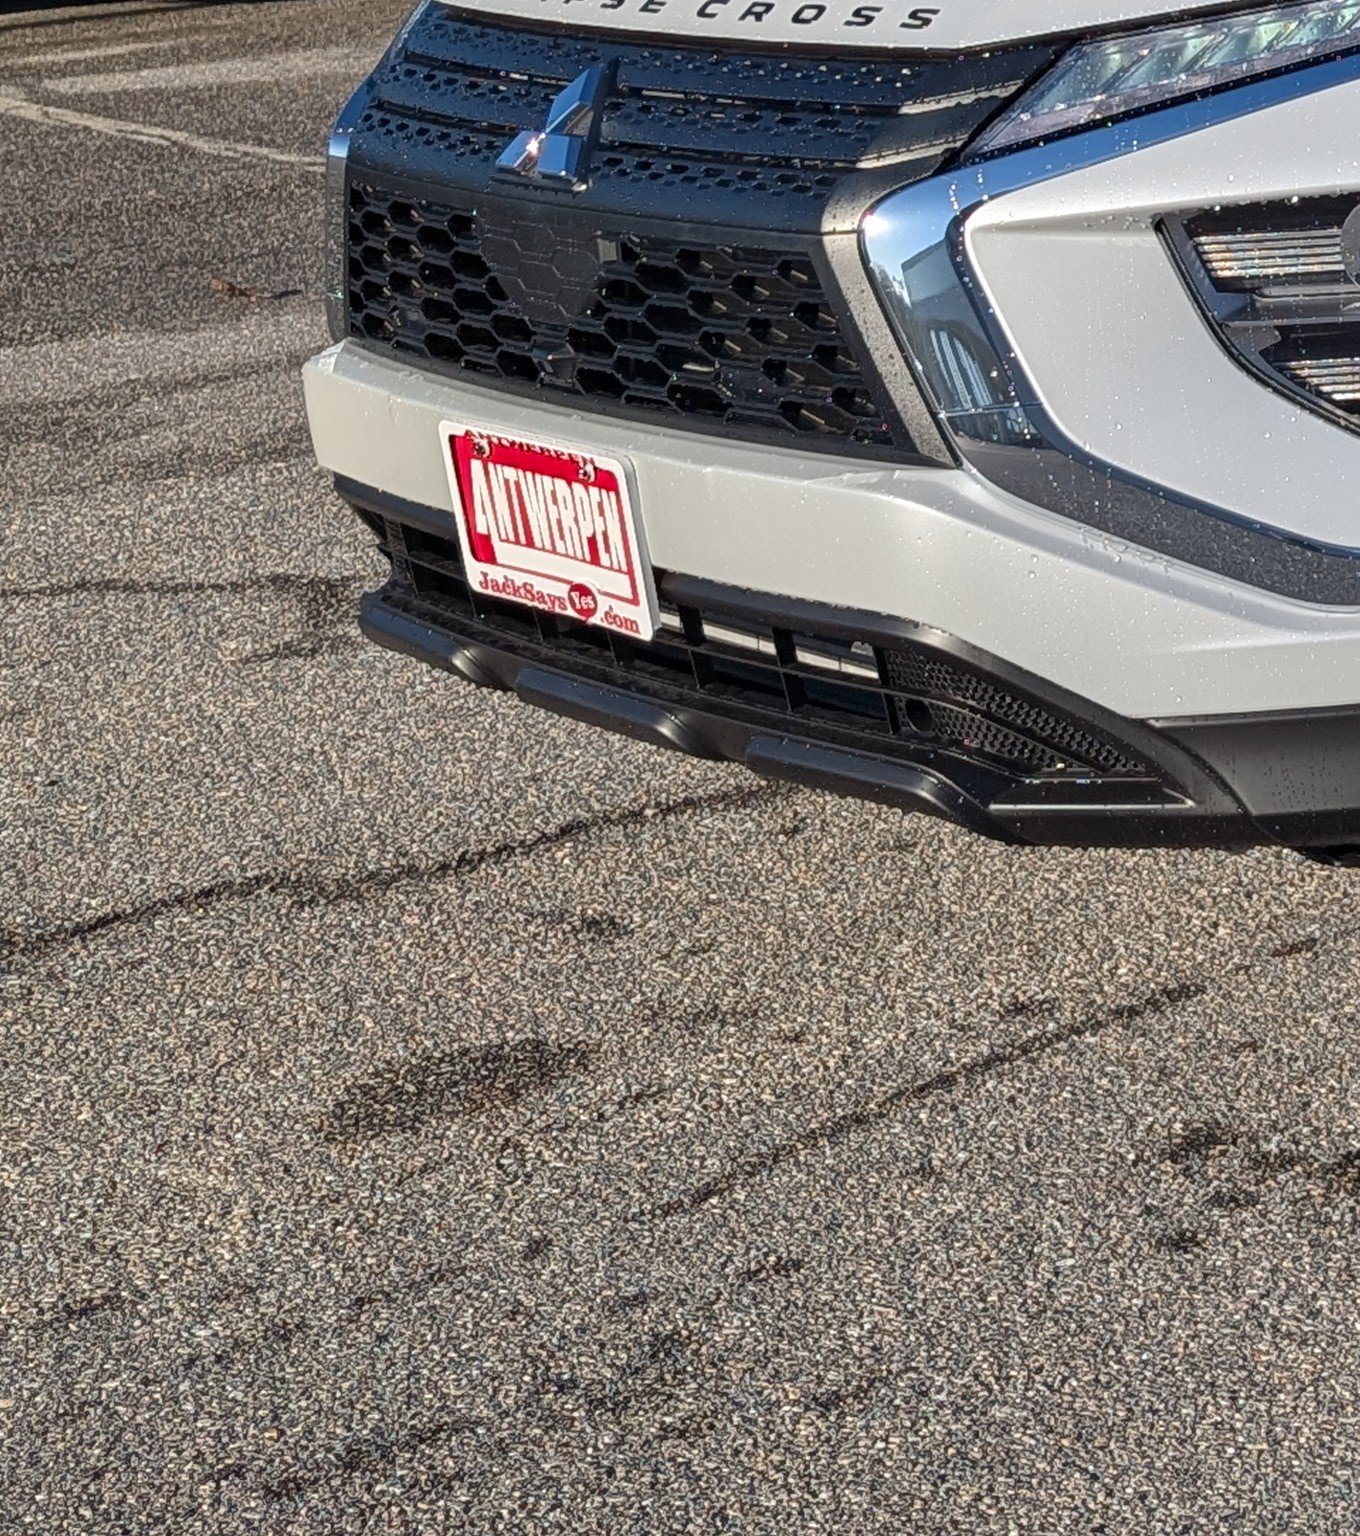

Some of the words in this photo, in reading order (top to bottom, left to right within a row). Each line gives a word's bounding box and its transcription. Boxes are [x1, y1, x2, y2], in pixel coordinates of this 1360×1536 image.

[470, 458, 629, 574] ANTWERPEN
[479, 571, 568, 612] JackSays
[571, 591, 596, 611] Yes
